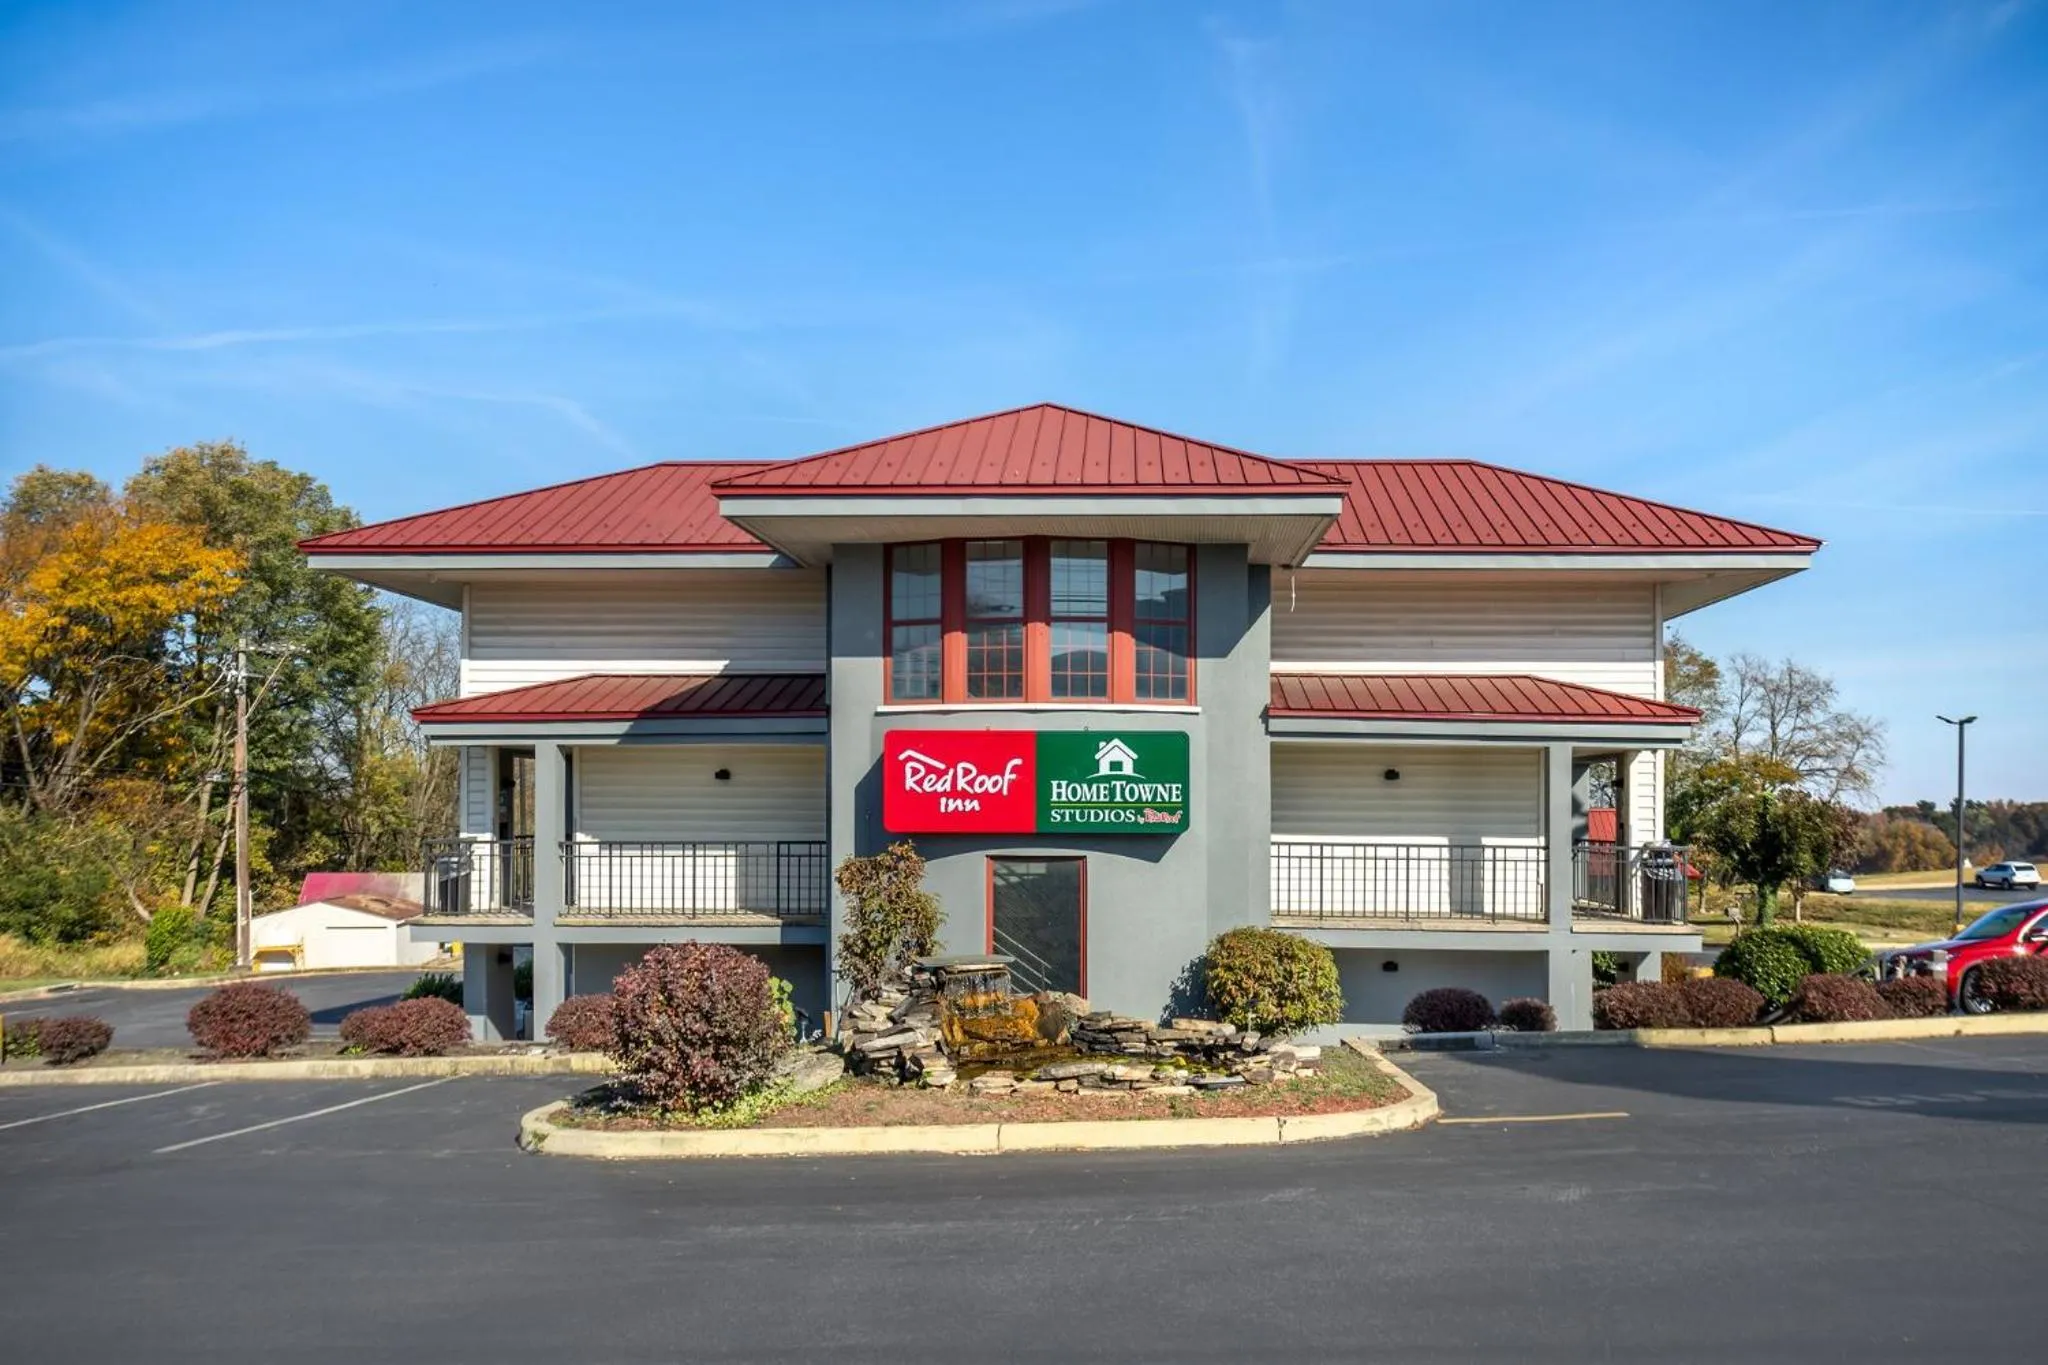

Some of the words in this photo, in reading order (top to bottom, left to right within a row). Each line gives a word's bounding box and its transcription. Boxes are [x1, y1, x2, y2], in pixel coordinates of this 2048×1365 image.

[905, 761, 955, 794] Red
[956, 758, 1023, 796] Roof
[940, 797, 981, 813] Inn
[1050, 808, 1136, 823] STUDIOS
